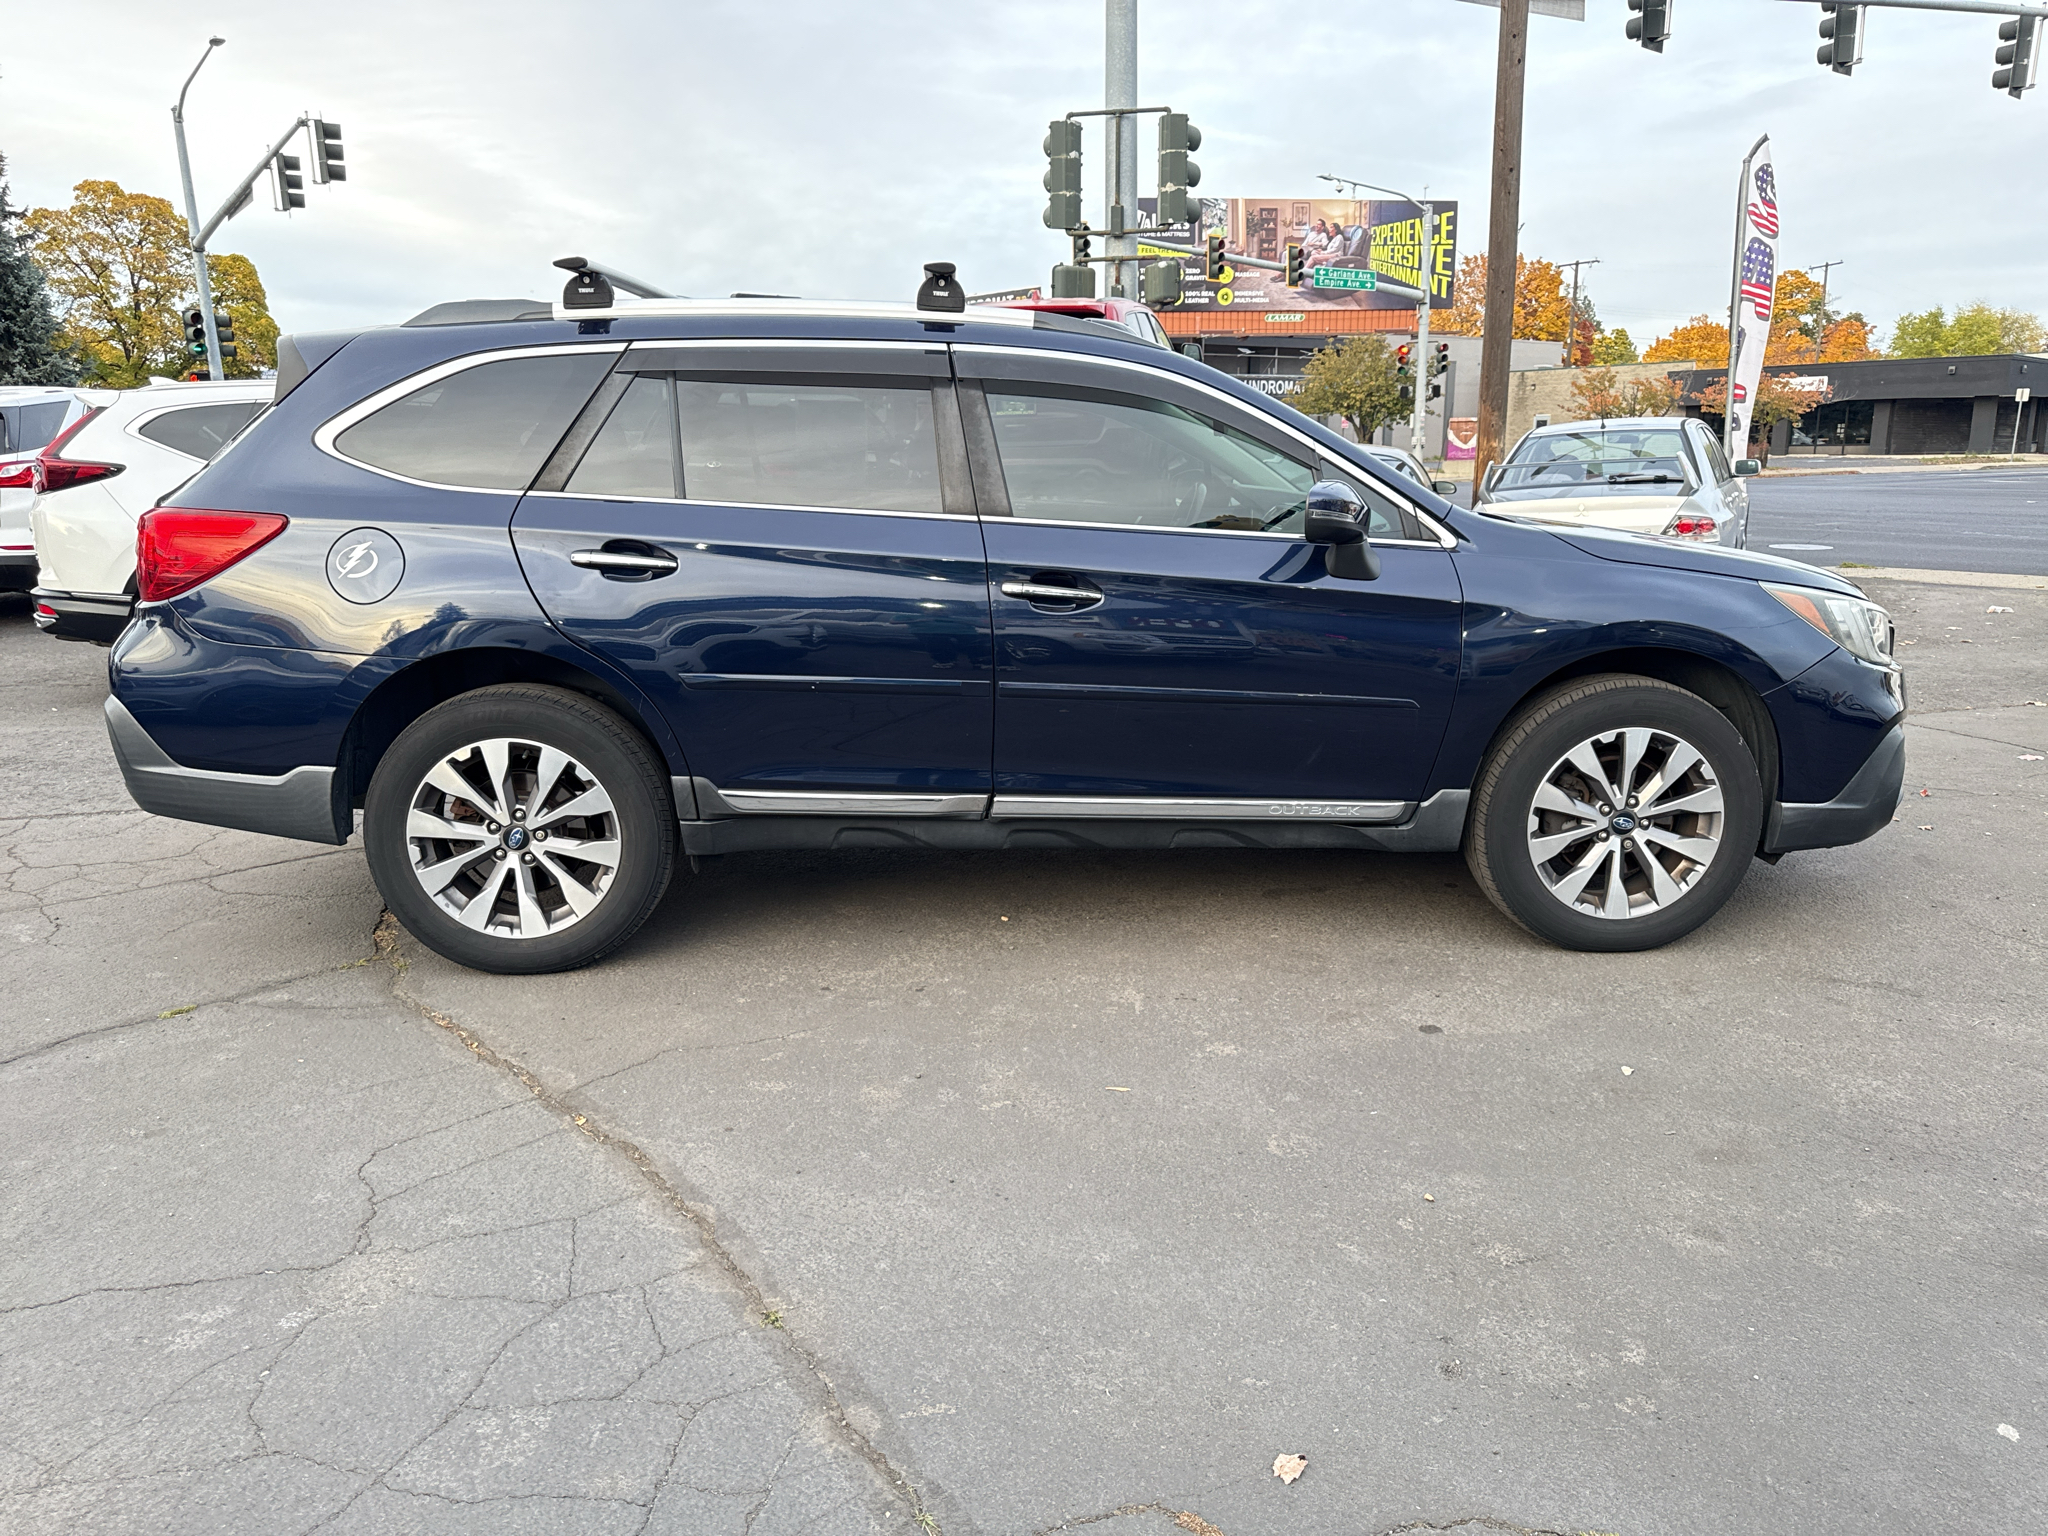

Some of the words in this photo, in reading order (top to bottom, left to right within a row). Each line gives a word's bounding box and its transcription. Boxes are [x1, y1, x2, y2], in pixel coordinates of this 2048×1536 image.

[1371, 211, 1454, 245] EXPERIENE
[1328, 269, 1355, 279] Garland
[1358, 270, 1373, 280] Ave.
[1319, 277, 1344, 287] Empire
[1347, 280, 1362, 288] Ave.
[1269, 805, 1361, 816] OUTBACK
